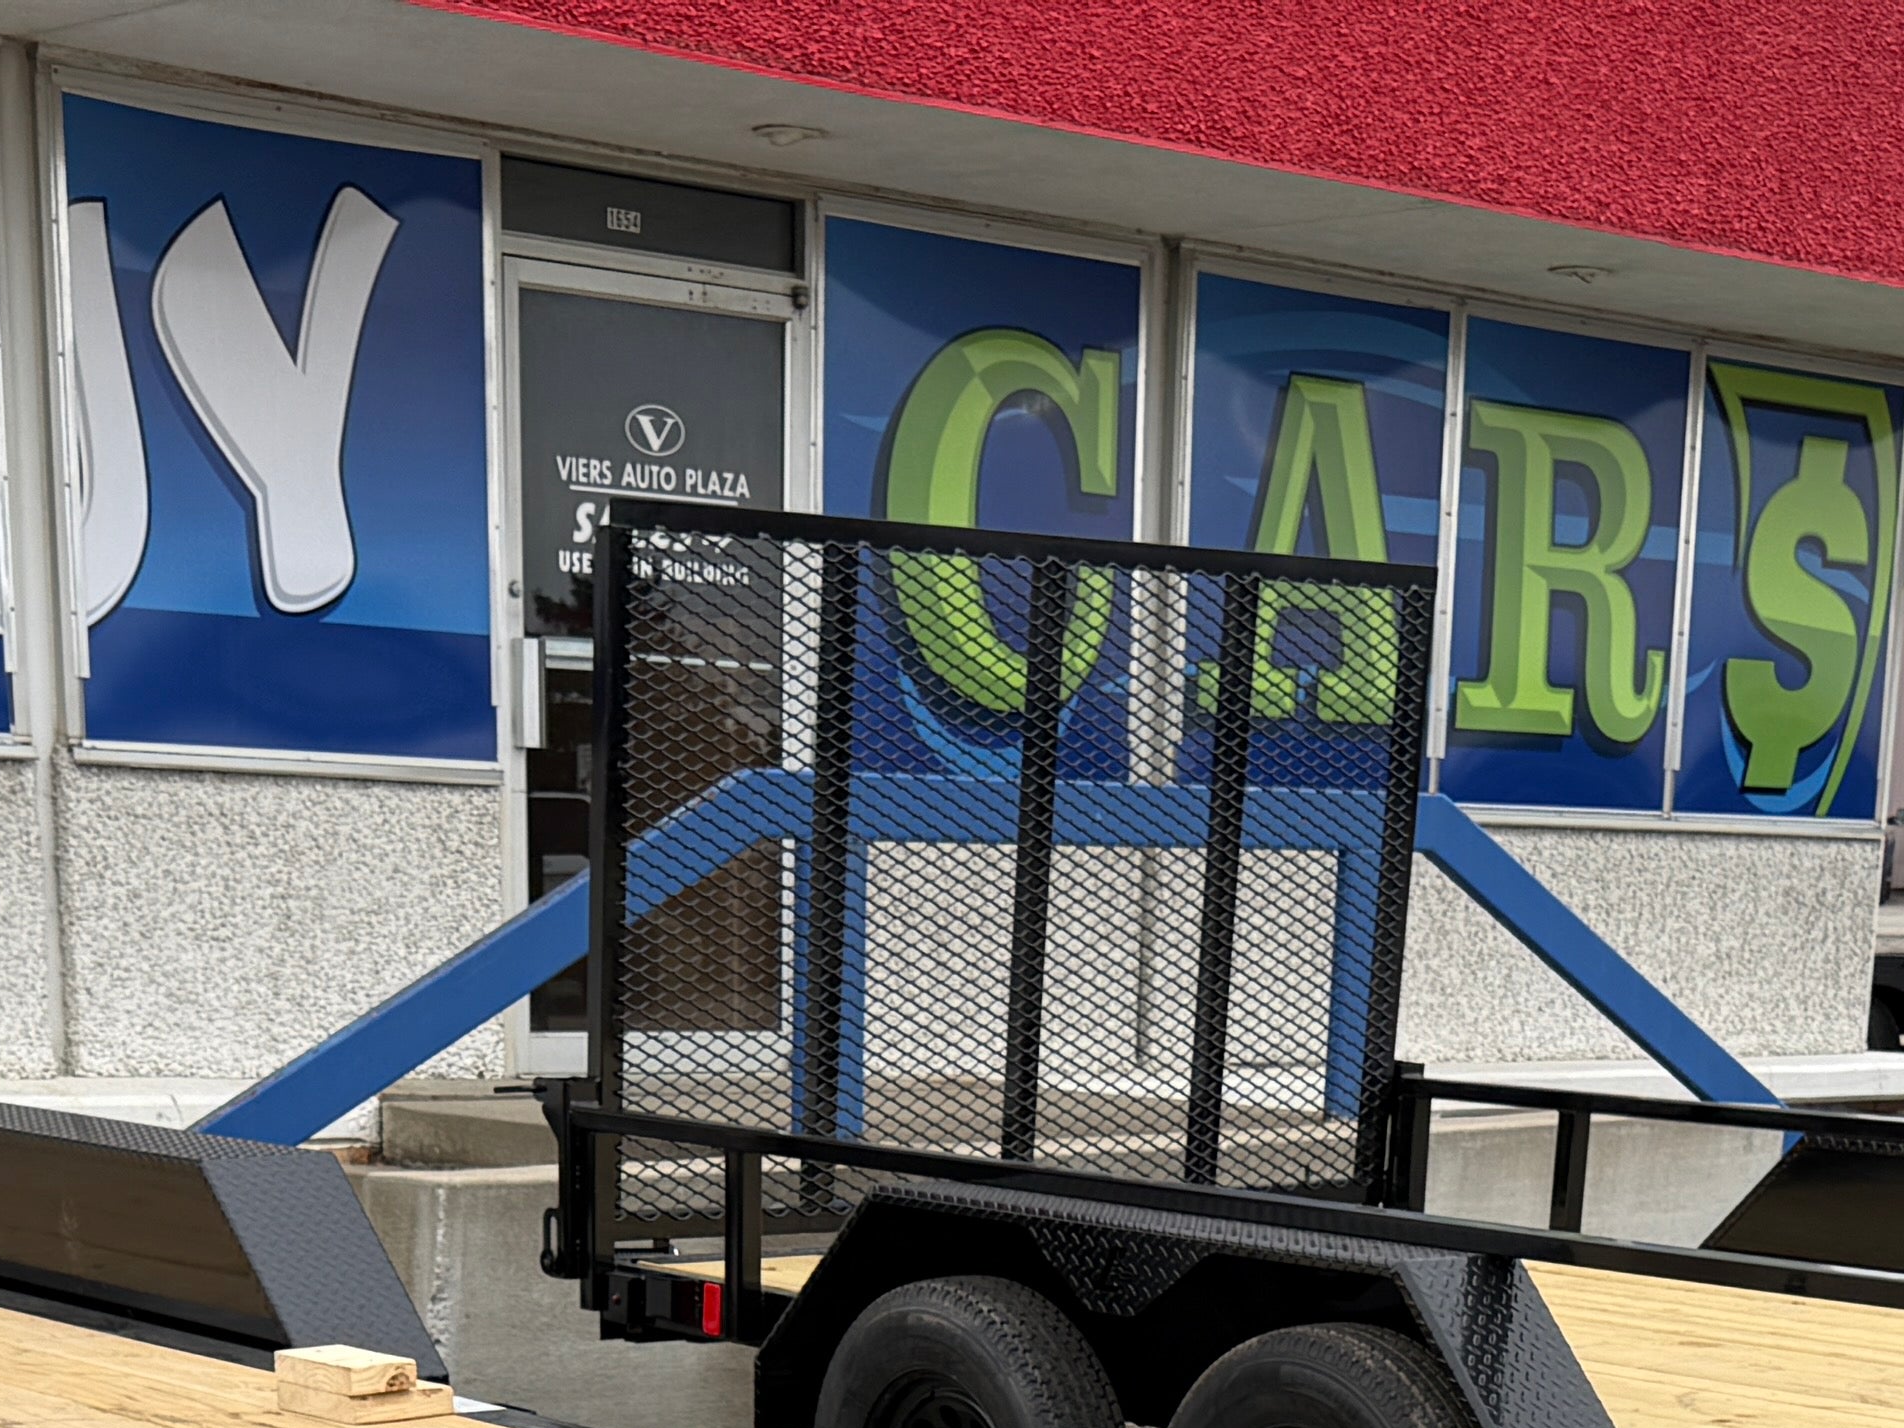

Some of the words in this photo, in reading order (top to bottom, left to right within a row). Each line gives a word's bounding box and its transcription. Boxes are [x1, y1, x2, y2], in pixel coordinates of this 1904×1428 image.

[556, 455, 613, 486] VIERS
[621, 462, 677, 492] AUTO
[685, 468, 751, 499] PLAZA
[558, 550, 594, 574] USE
